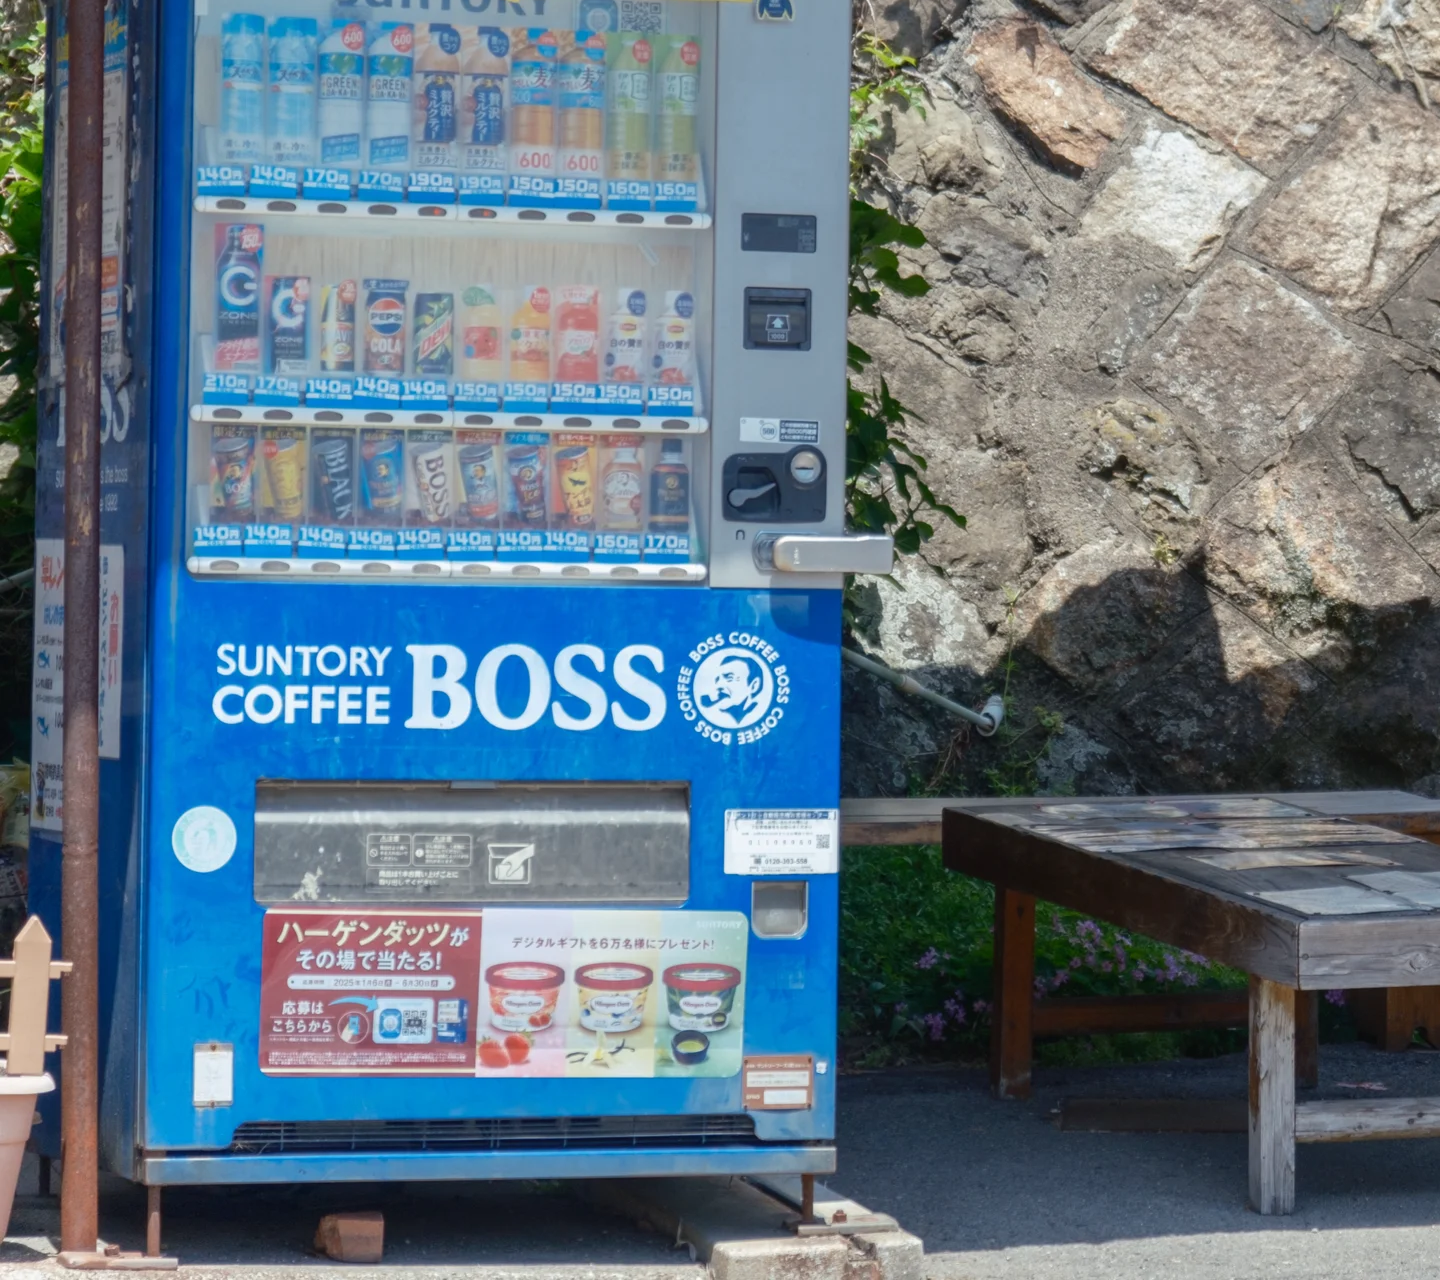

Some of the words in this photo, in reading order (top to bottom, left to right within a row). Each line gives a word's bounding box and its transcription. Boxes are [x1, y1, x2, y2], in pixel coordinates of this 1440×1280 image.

[425, 453, 450, 519] BOSS
[216, 643, 392, 678] SUNTORY
[403, 643, 666, 731] BOSS
[211, 685, 391, 725] COFFEE
[277, 919, 469, 947] ハーゲンダッツが
[511, 936, 715, 951] デジタルギフトを6万名様にプレゼント!
[295, 949, 442, 971] その場で当たる!
[281, 1000, 324, 1016] 応募は
[272, 1018, 332, 1033] こちらから
